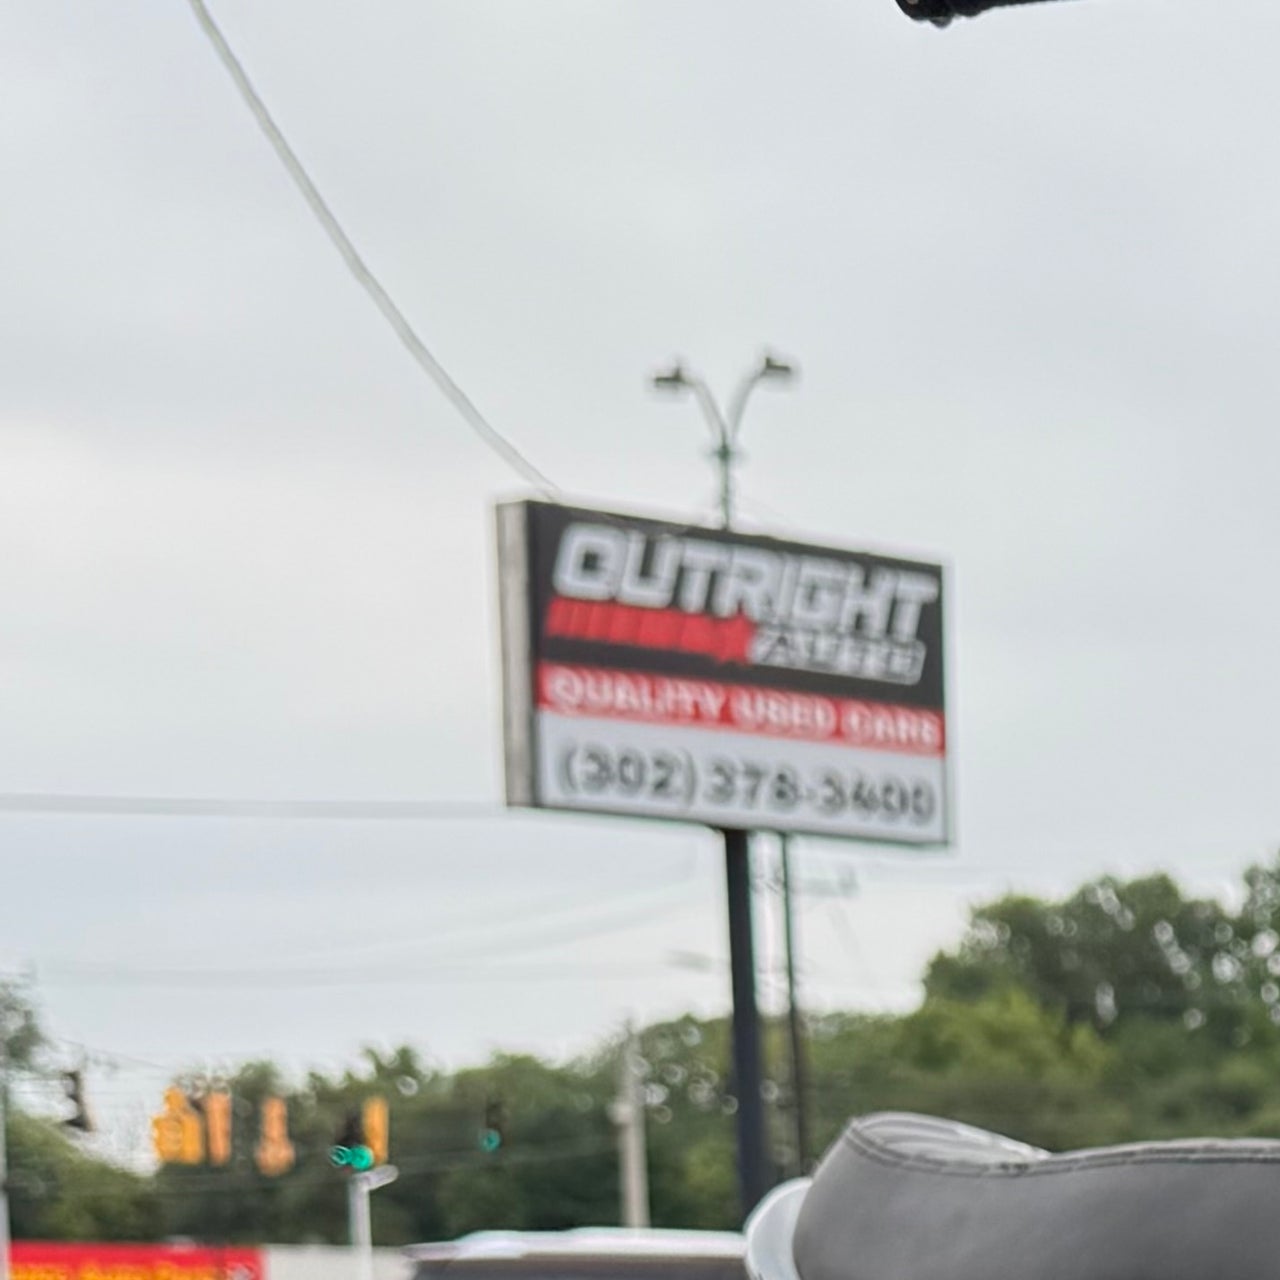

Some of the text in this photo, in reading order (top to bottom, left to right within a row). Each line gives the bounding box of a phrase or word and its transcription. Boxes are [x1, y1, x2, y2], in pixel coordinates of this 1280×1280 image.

[553, 522, 939, 642] OUTRIGHT
[550, 668, 938, 746] QUALITY USED CARS
[561, 743, 695, 807] (302)
